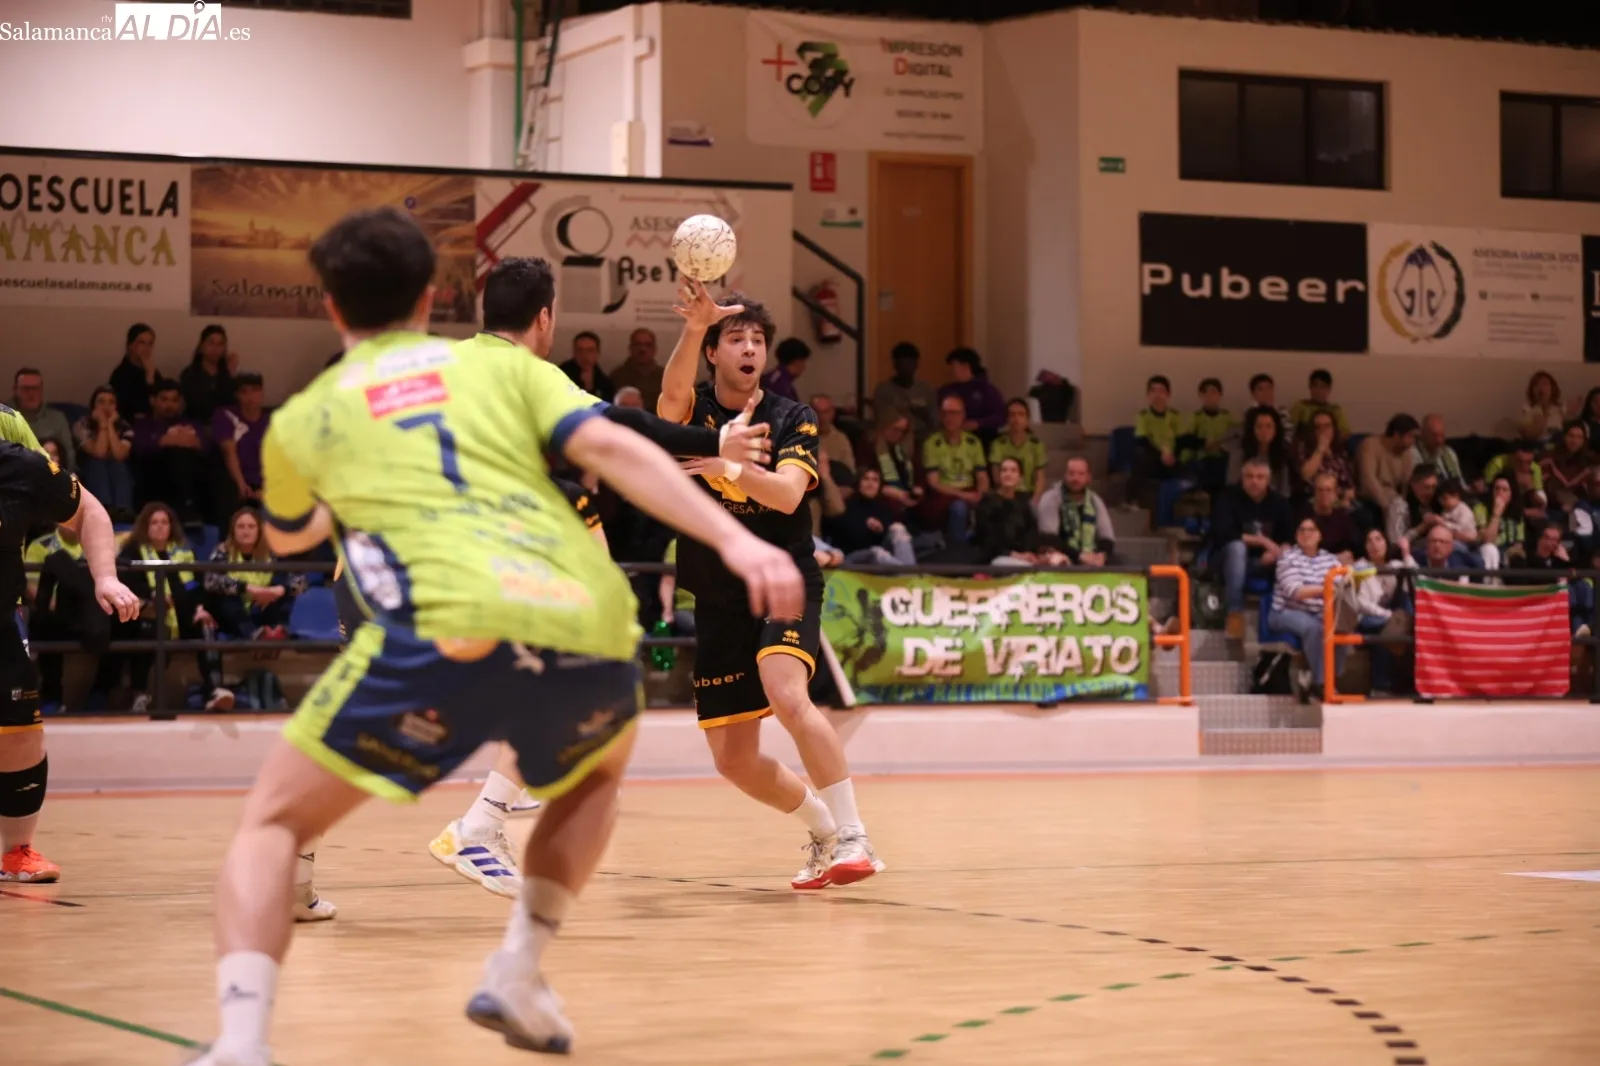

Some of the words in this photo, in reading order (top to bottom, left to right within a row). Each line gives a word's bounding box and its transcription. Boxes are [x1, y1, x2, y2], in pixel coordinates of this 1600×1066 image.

[0, 173, 178, 217] OESCUELA
[212, 278, 320, 299] Salaman
[1141, 262, 1366, 304] Pubeer
[393, 412, 468, 492] 7
[881, 582, 1139, 629] GUERREROS
[902, 636, 963, 677] DE
[692, 672, 745, 688] ubeer
